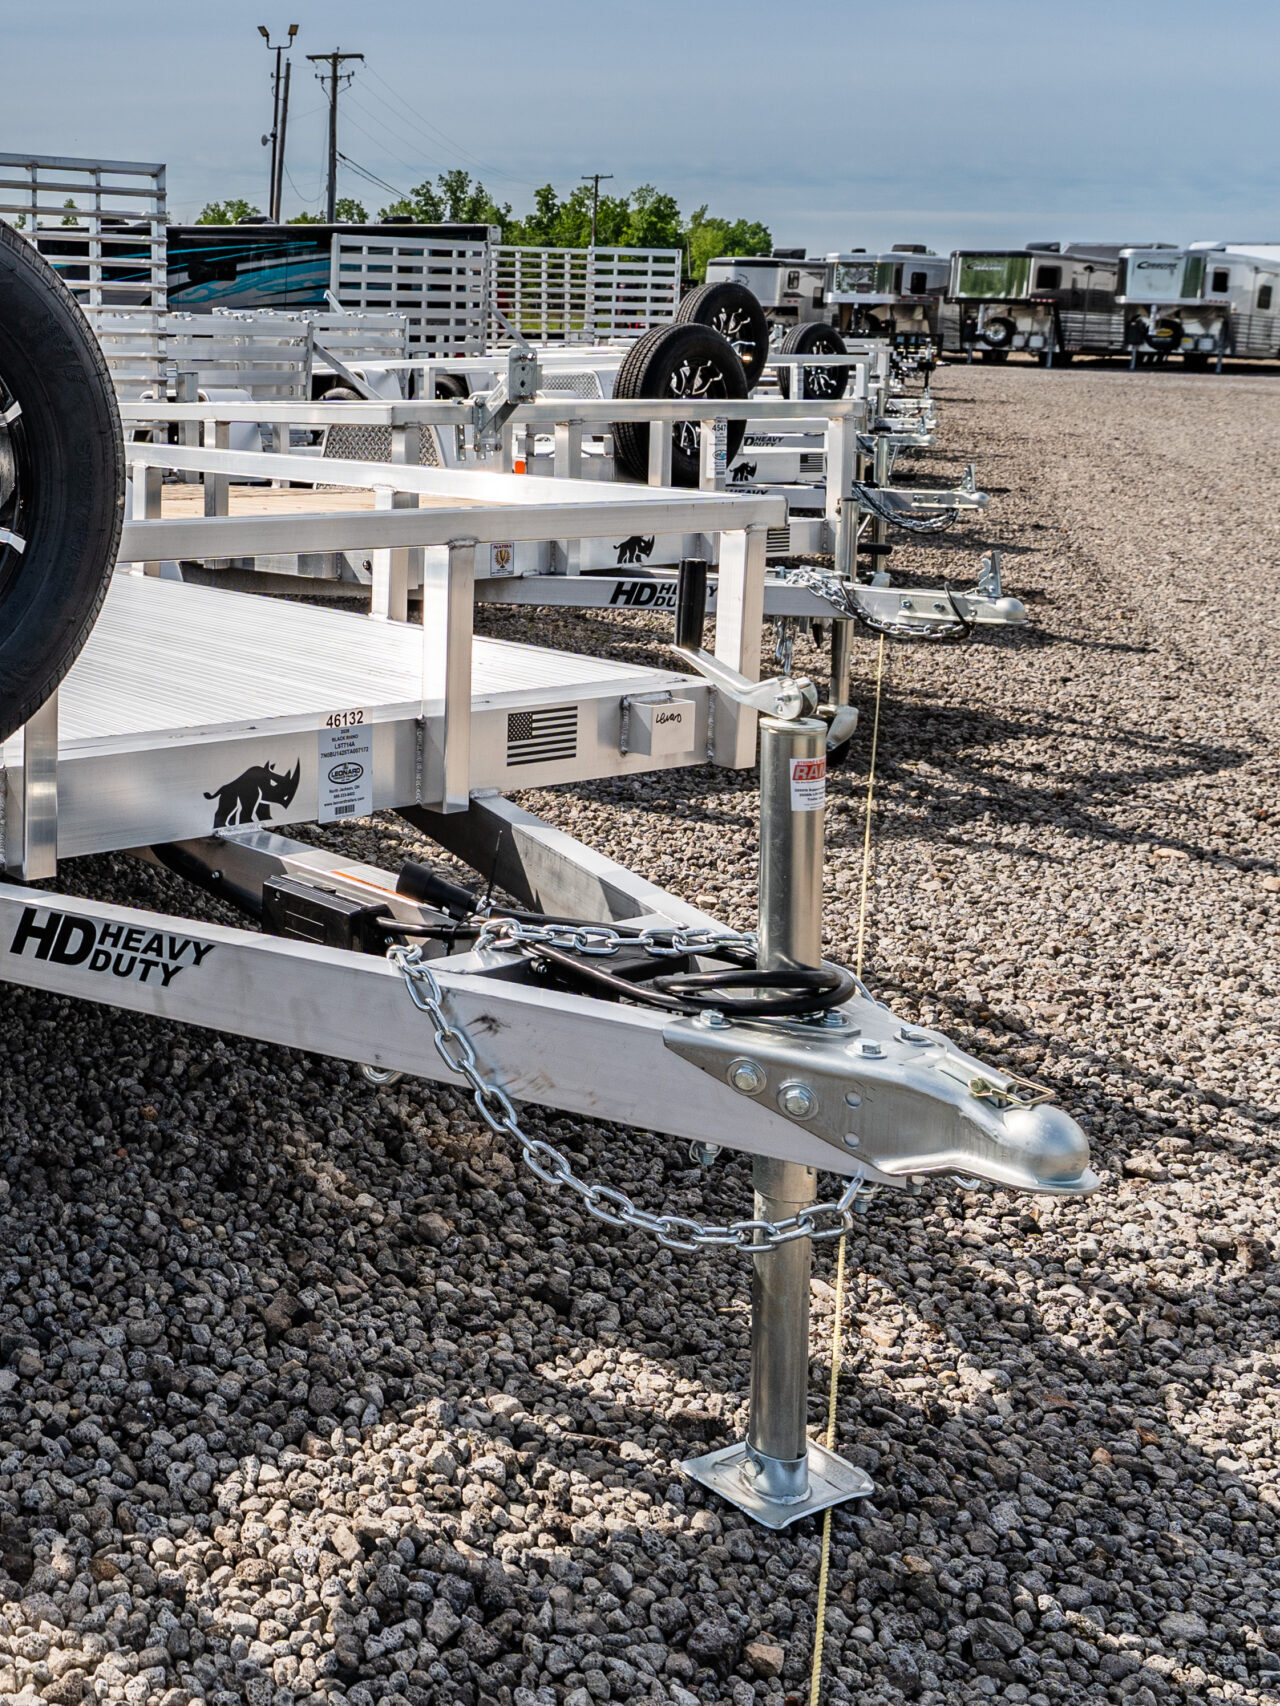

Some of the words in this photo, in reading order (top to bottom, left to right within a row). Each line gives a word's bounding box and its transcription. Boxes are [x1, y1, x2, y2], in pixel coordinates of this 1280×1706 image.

[609, 581, 658, 606] HD
[326, 710, 364, 728] 46132
[331, 768, 361, 778] LEONARD
[9, 906, 97, 966] HD
[97, 923, 216, 966] HEAVY
[88, 948, 184, 987] DUTY
